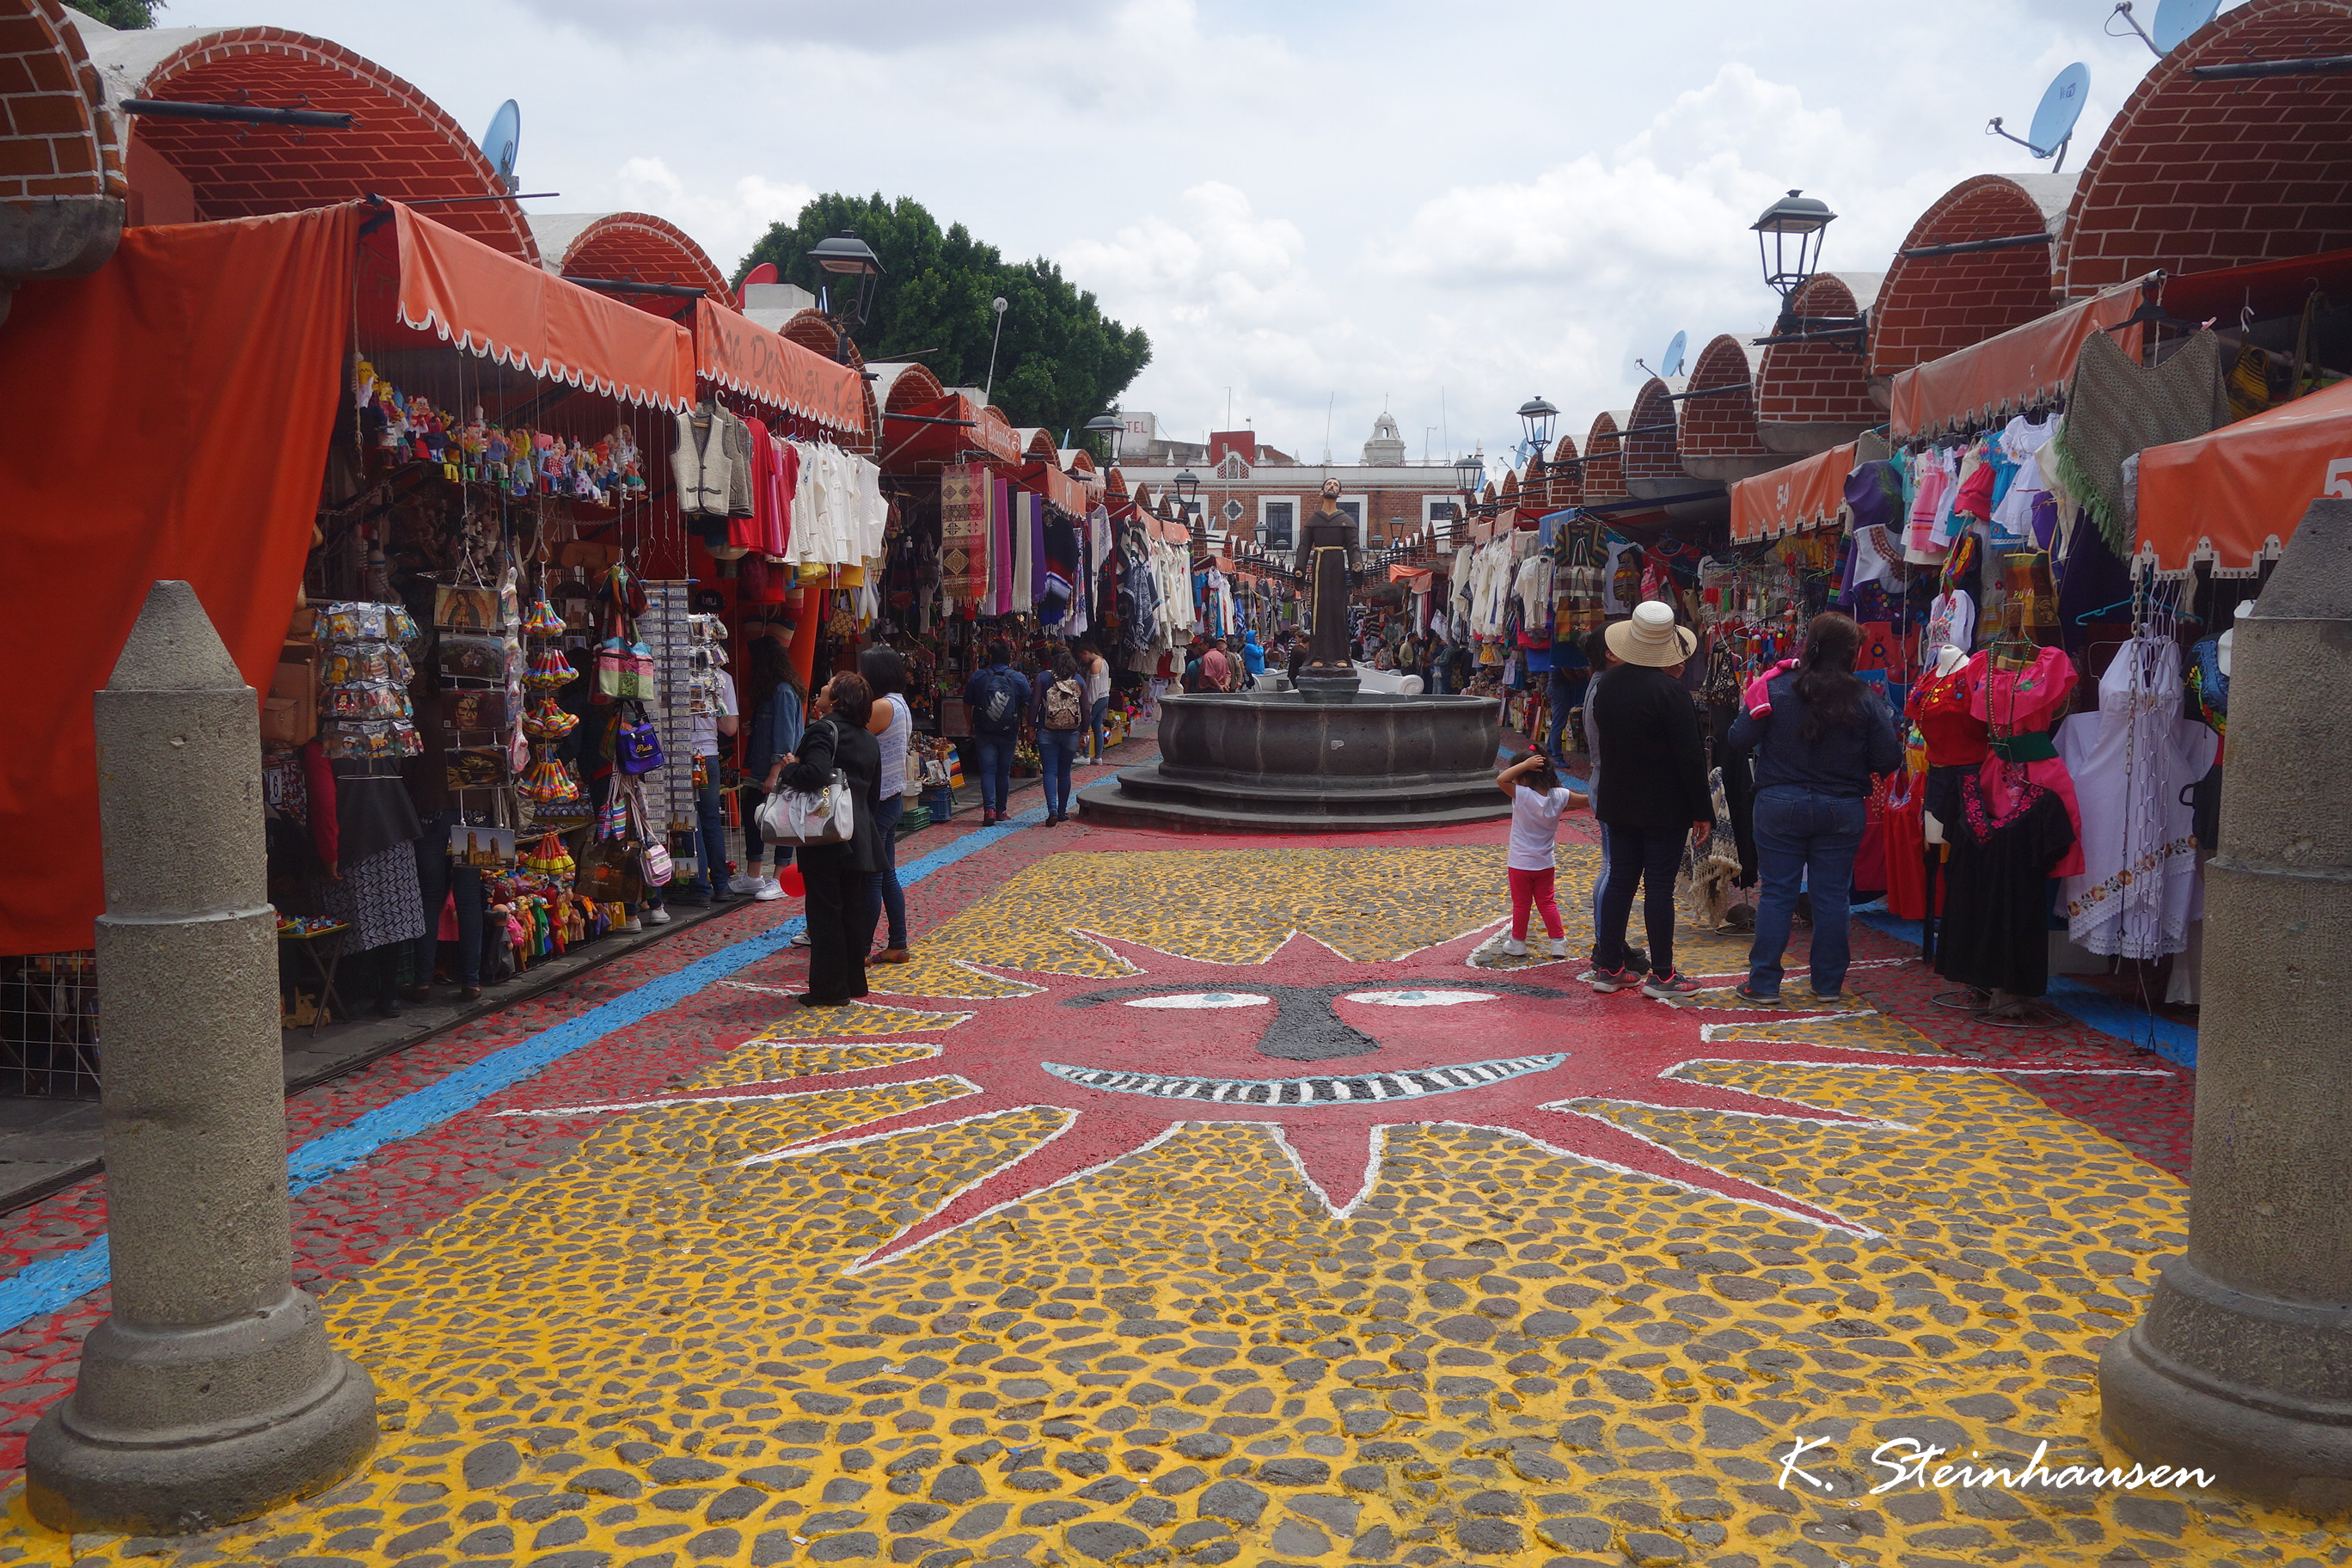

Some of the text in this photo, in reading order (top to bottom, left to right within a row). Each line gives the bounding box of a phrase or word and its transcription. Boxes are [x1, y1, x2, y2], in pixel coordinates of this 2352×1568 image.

[1118, 420, 1148, 433] TEL
[1776, 481, 1789, 511] 54
[986, 690, 1010, 722] NIKE
[273, 775, 279, 798] 6
